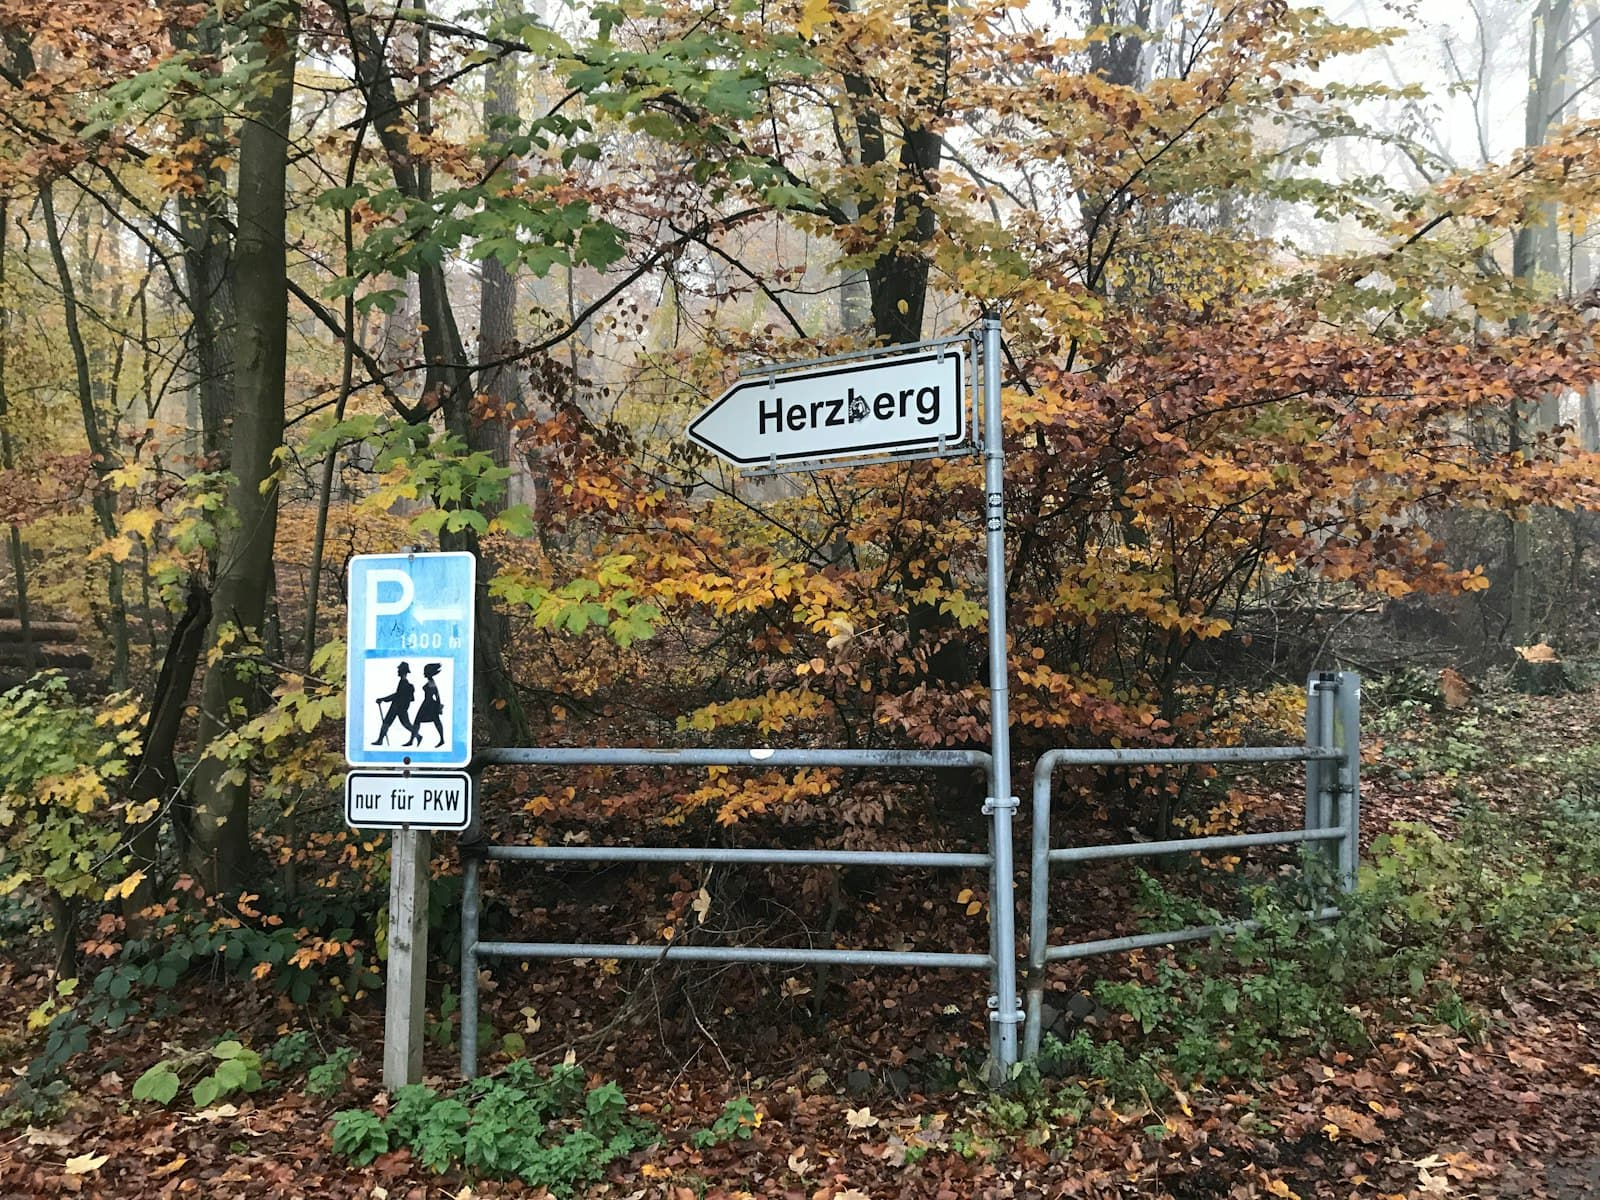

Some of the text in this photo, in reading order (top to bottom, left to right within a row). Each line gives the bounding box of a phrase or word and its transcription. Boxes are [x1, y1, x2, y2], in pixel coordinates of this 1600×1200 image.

[759, 385, 940, 434] Herzberg
[366, 568, 414, 649] P
[356, 788, 460, 811] nur für PKW
